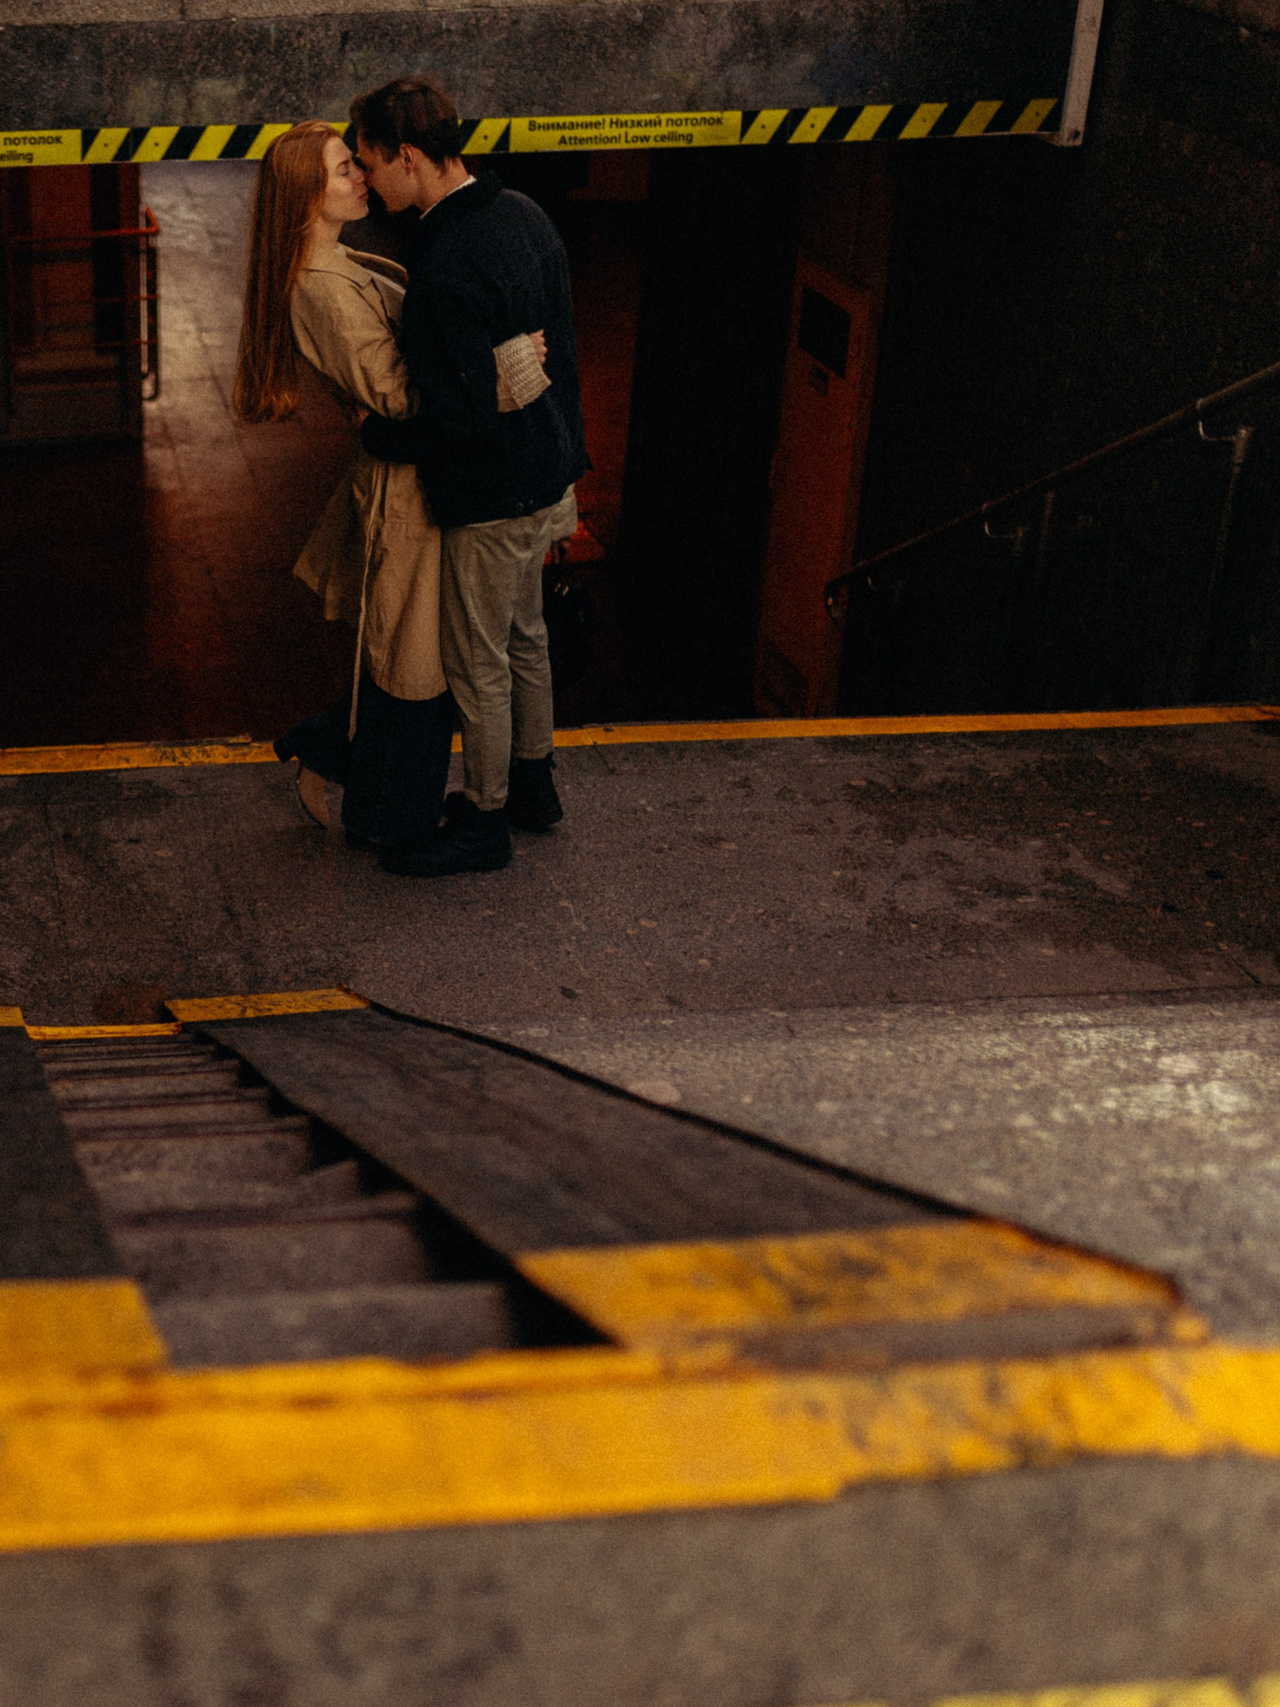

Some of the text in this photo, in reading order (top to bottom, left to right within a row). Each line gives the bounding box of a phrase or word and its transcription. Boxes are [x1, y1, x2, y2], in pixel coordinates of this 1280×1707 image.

[528, 115, 724, 132] Внимание! Низкий потолок
[4, 134, 63, 146] потолок
[558, 131, 694, 146] Attention! Low ceiling
